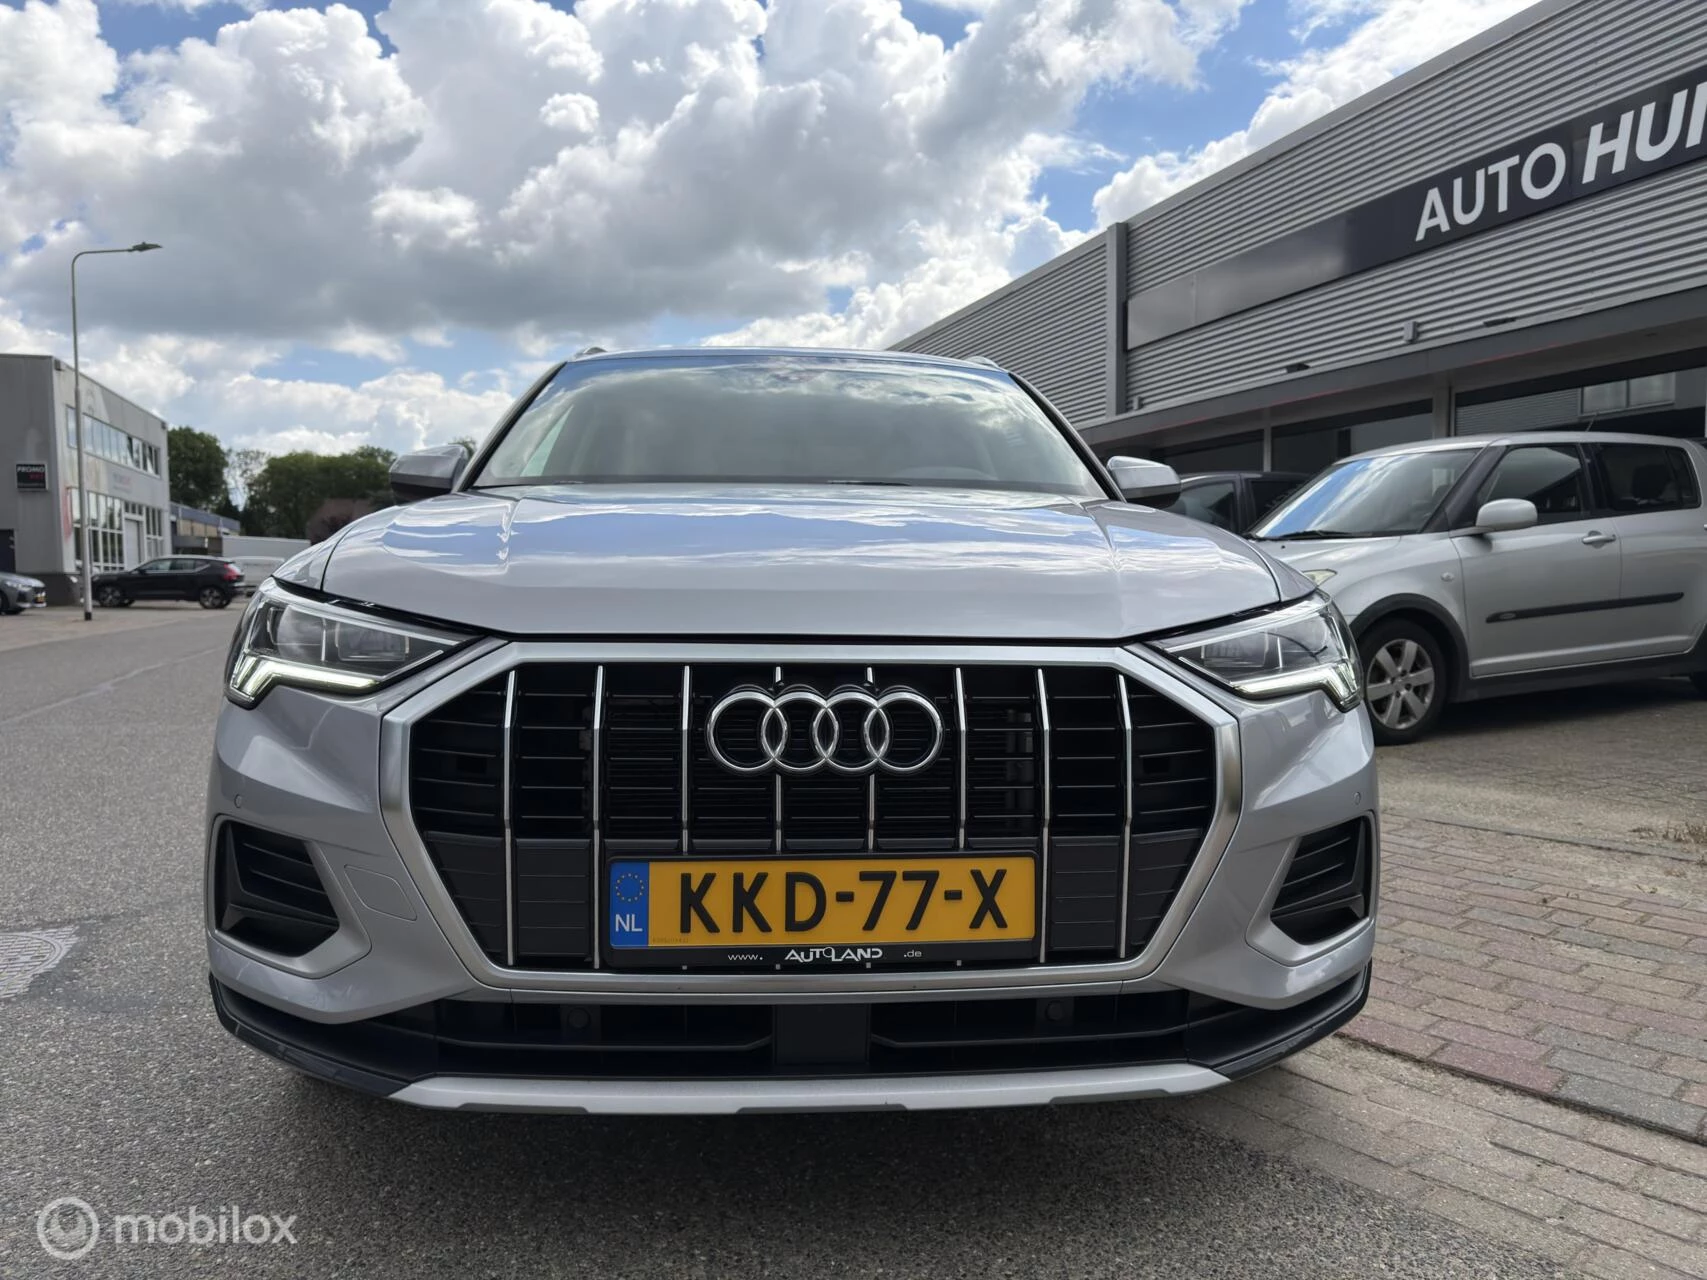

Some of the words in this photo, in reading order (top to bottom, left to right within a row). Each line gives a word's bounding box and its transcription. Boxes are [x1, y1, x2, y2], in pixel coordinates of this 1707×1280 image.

[1415, 142, 1567, 242] AUTO
[679, 868, 1008, 934] KKD-77-X
[614, 914, 643, 932] NL
[727, 953, 763, 961] www.
